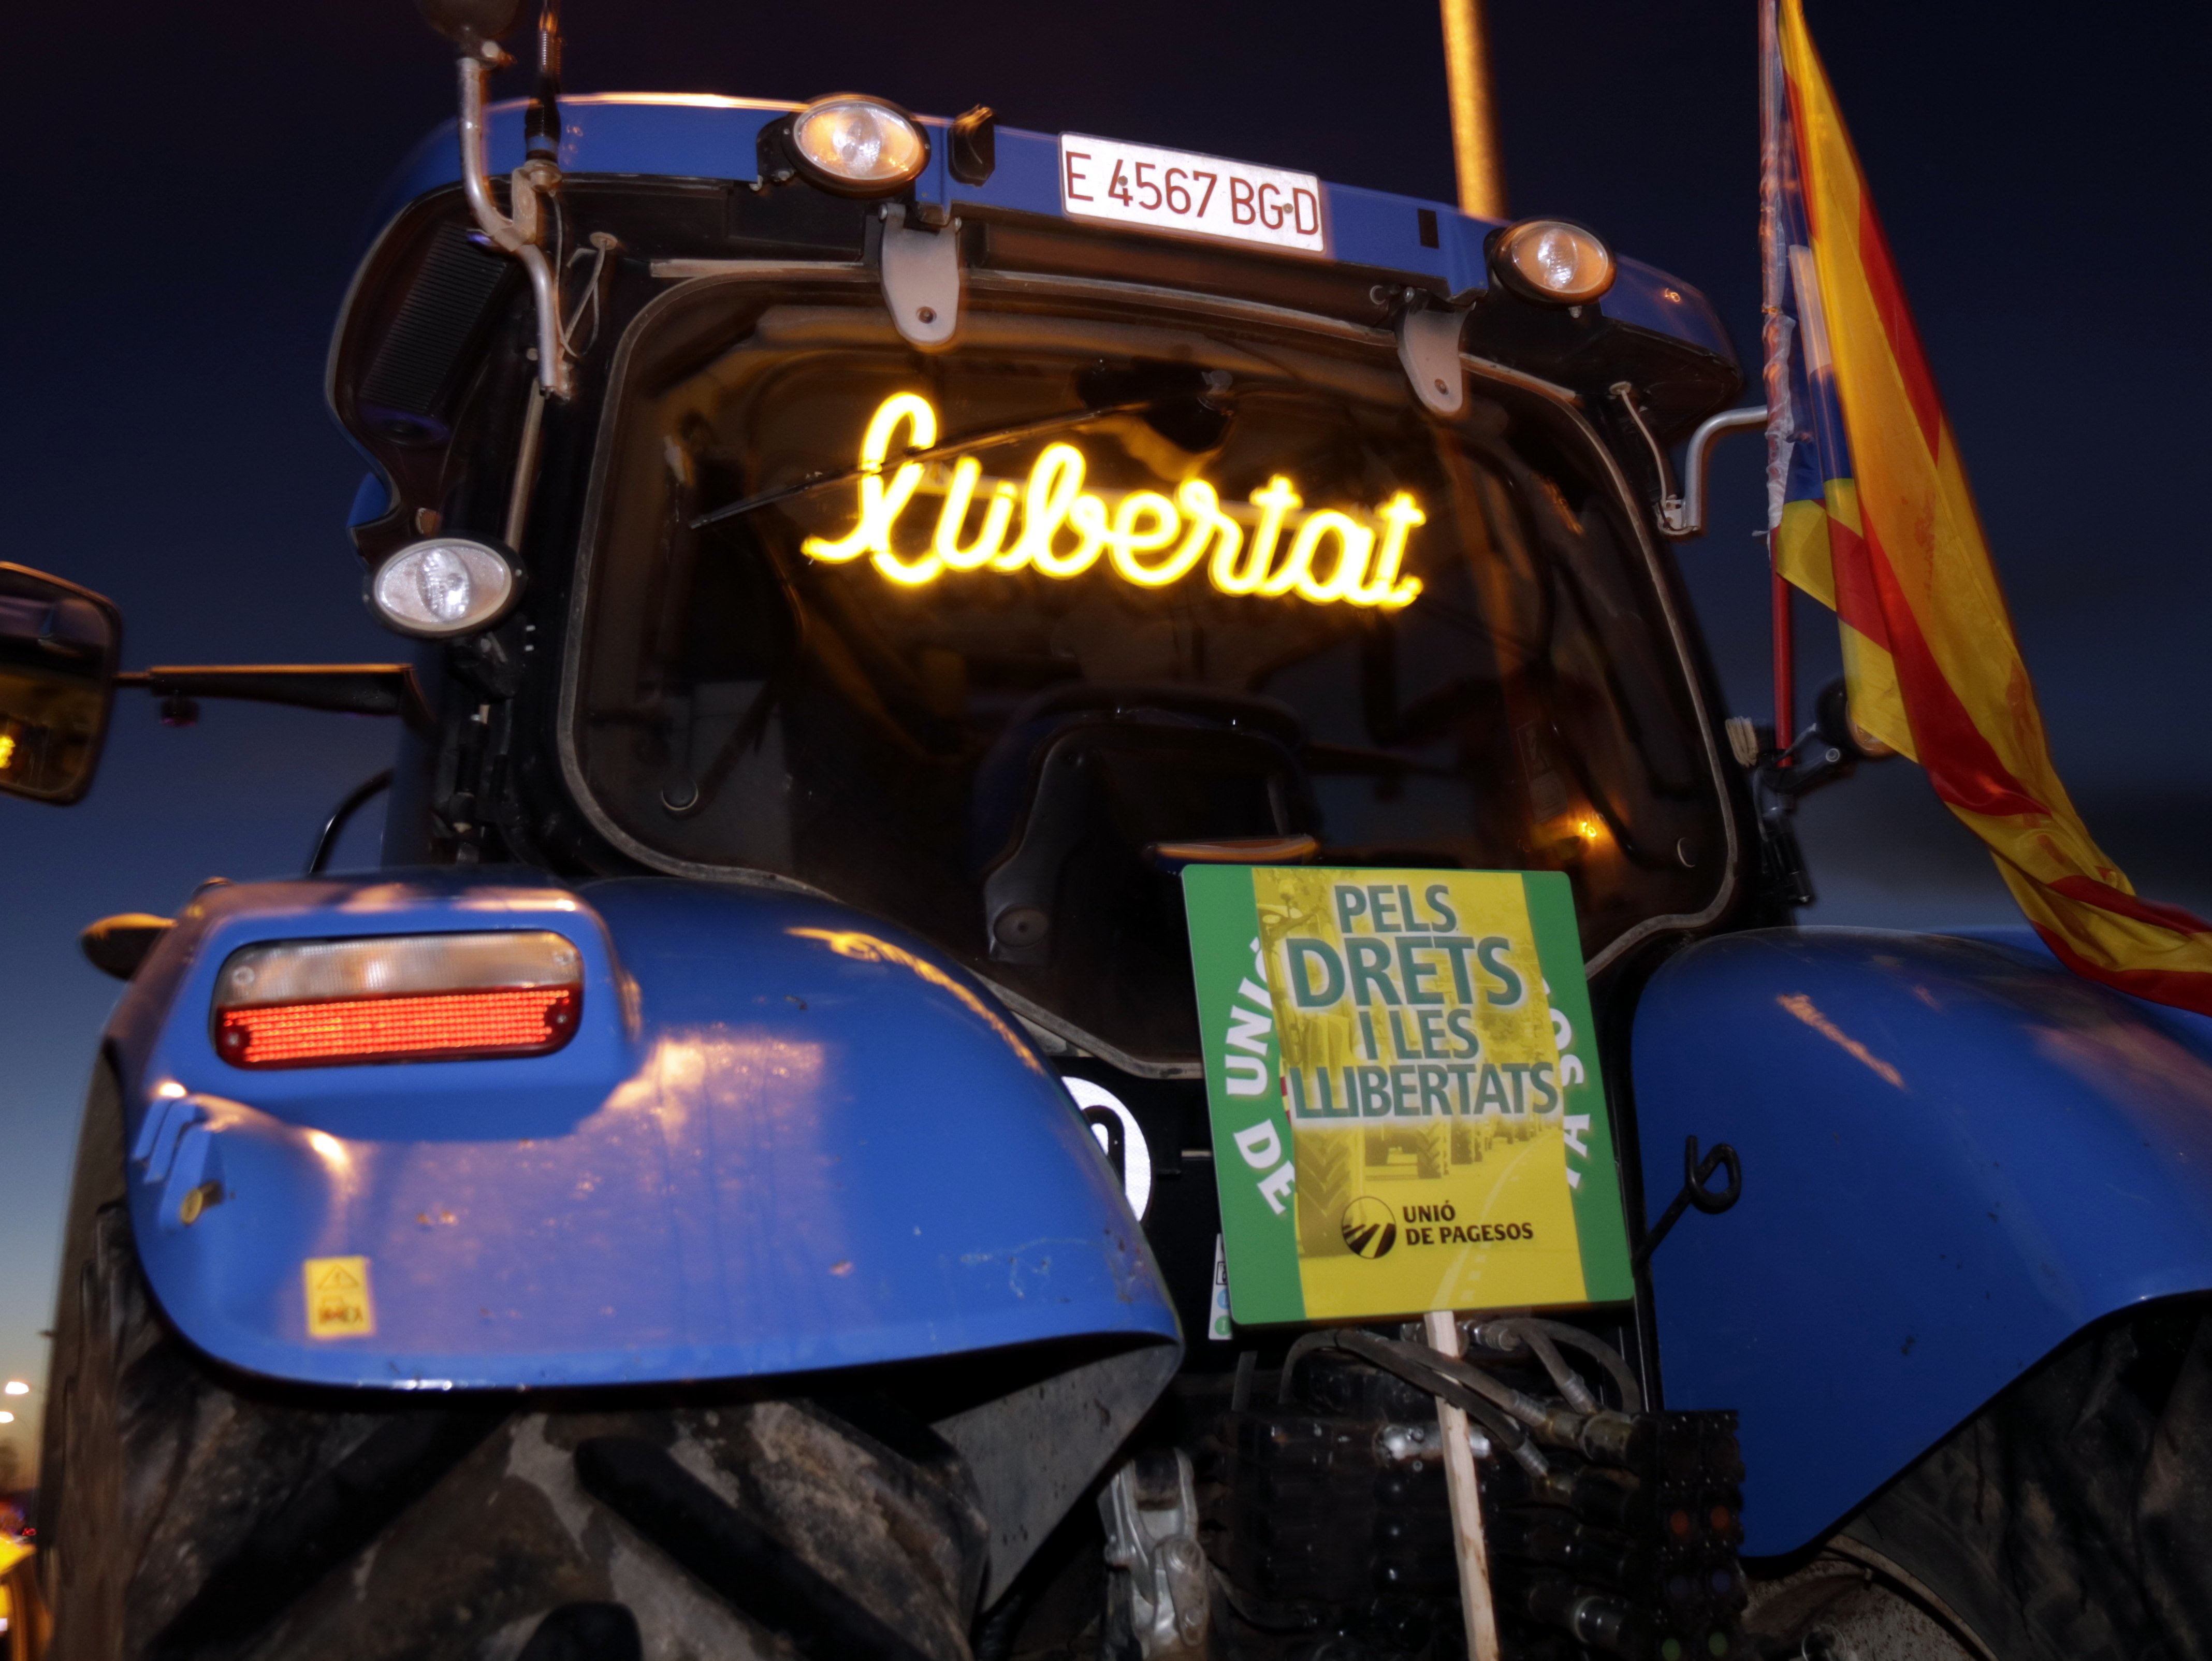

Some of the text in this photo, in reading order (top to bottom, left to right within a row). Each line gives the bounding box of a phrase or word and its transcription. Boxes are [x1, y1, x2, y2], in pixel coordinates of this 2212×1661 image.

[1066, 151, 1319, 235] E 4567 BGD
[800, 391, 1427, 610] Llibertat
[1334, 884, 1458, 933] PELS
[1285, 936, 1522, 1008] DRETS
[1358, 1008, 1479, 1061] I LES
[1289, 1061, 1559, 1119] LLIBERTATS
[1233, 1118, 1296, 1216] DE
[1403, 1200, 1456, 1223] UNIÓ
[1405, 1222, 1534, 1246] DE PAGESOS
